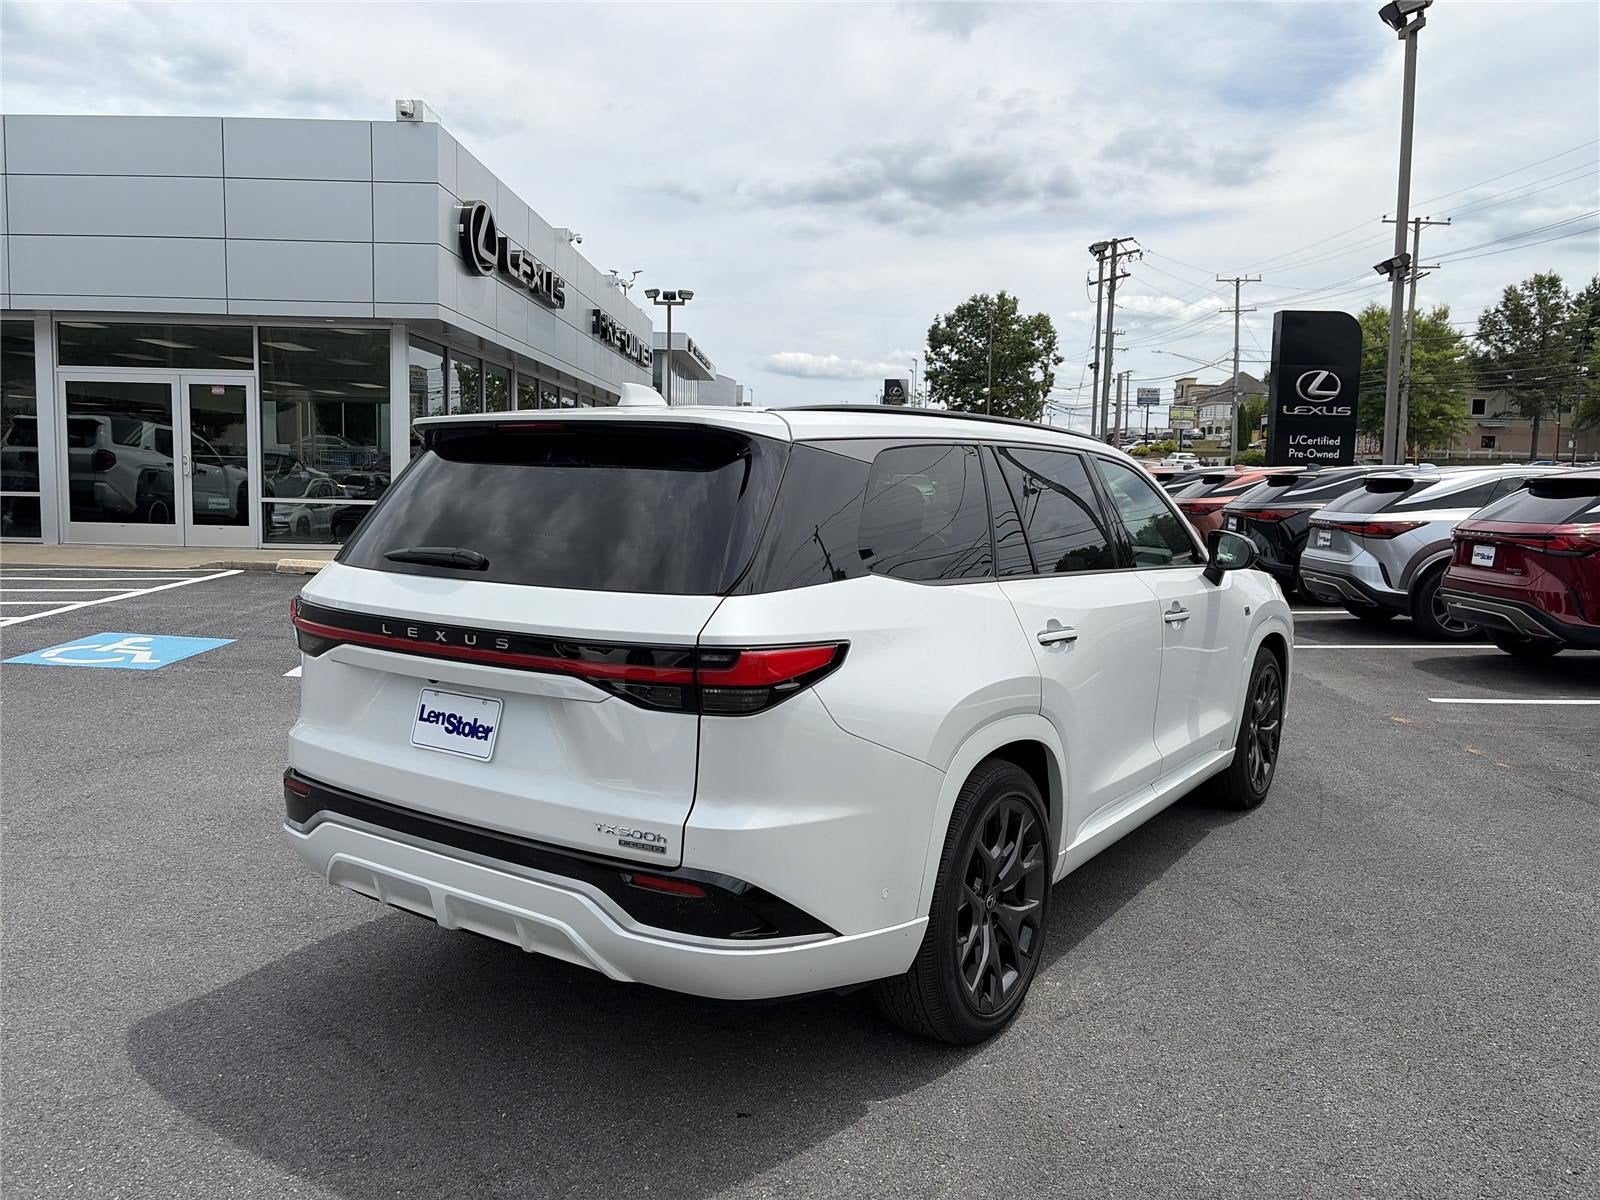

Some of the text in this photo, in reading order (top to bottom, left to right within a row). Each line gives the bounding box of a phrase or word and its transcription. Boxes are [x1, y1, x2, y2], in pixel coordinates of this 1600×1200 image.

[498, 237, 565, 309] LEXUS
[1282, 405, 1351, 416] LEXUS
[1289, 435, 1341, 446] L/Certified
[1288, 448, 1340, 459] Pre-Owned
[382, 623, 509, 649] LEXUS
